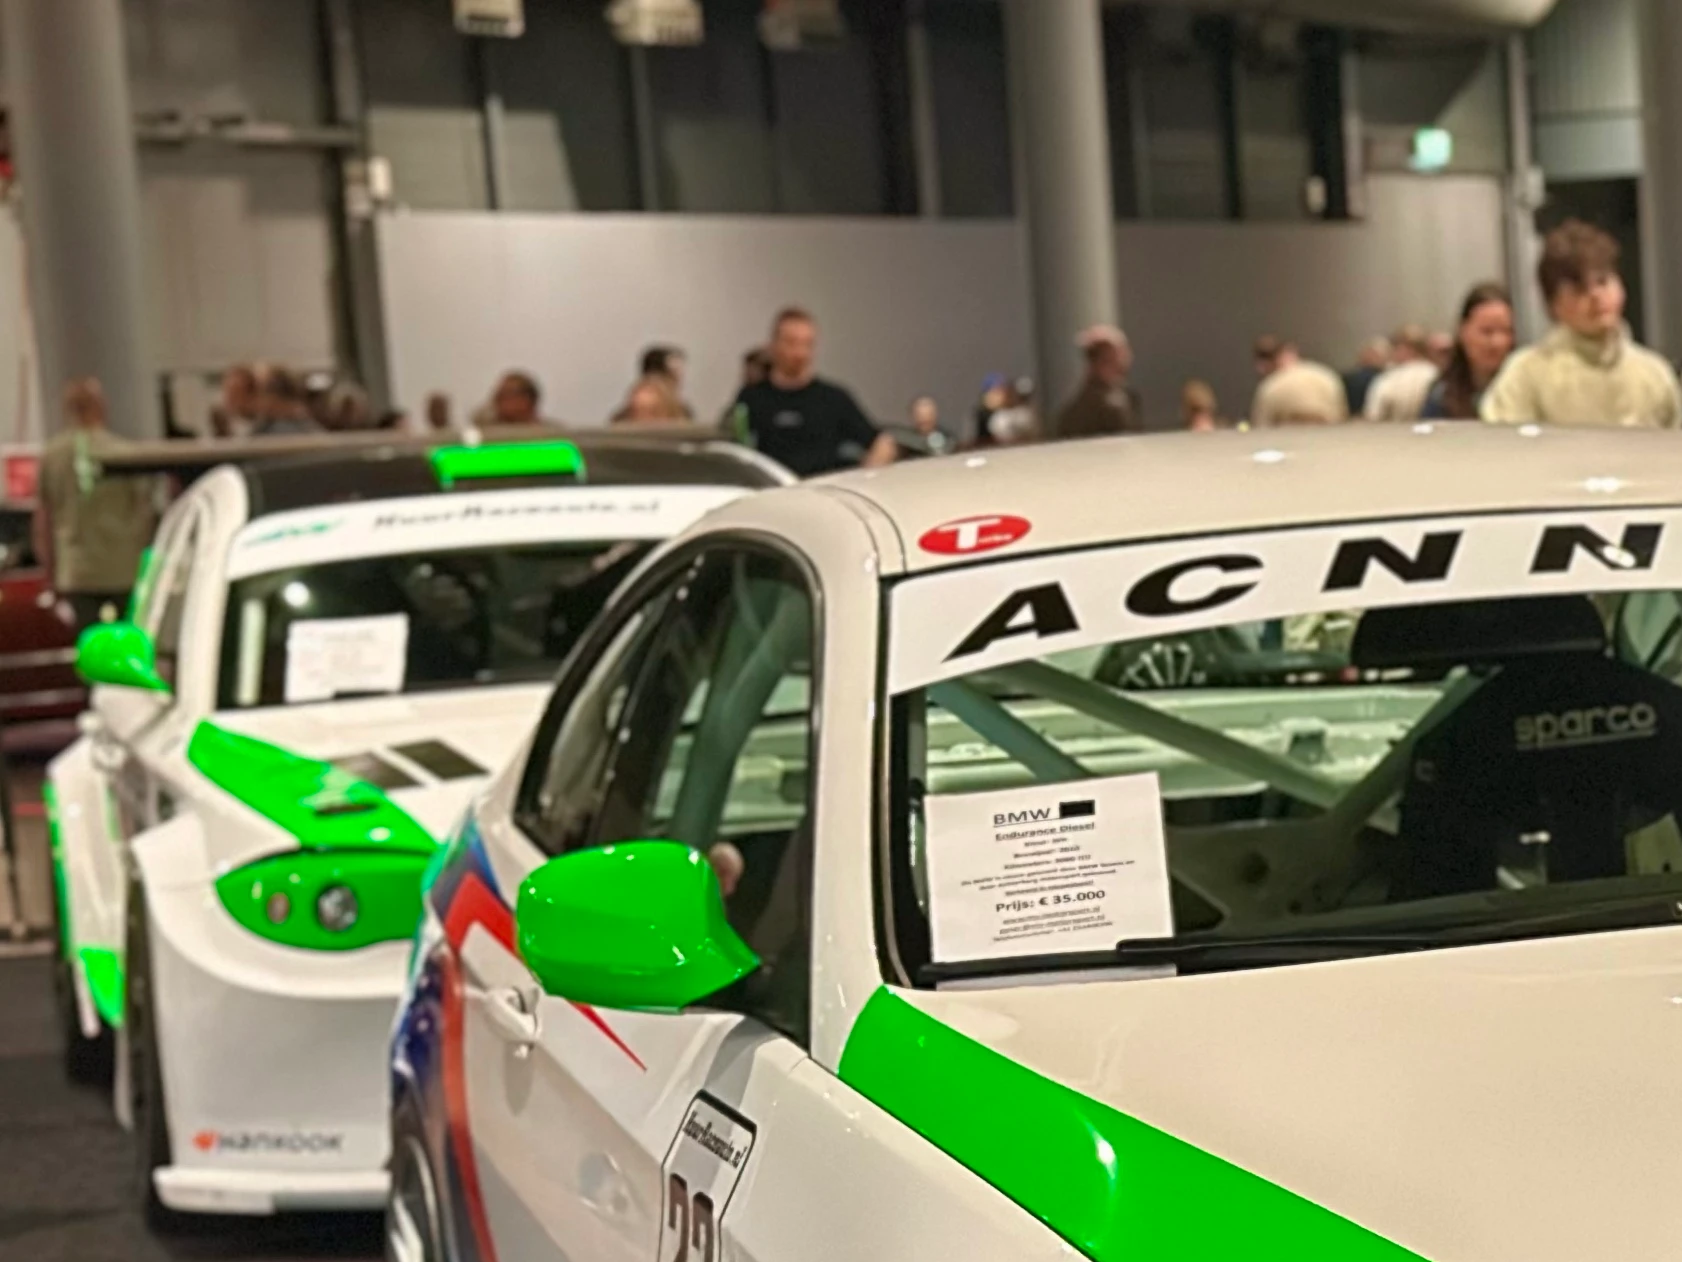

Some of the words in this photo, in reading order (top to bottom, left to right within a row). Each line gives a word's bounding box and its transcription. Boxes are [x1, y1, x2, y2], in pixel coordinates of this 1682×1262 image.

[941, 522, 1663, 662] ACNN
[1514, 703, 1657, 749] sparco
[994, 808, 1051, 825] BMW
[996, 828, 1057, 841] Endurance
[1060, 822, 1095, 833] Diesel
[996, 900, 1035, 913] Prijs:
[1039, 897, 1049, 906] €
[1053, 890, 1106, 905] 35.000
